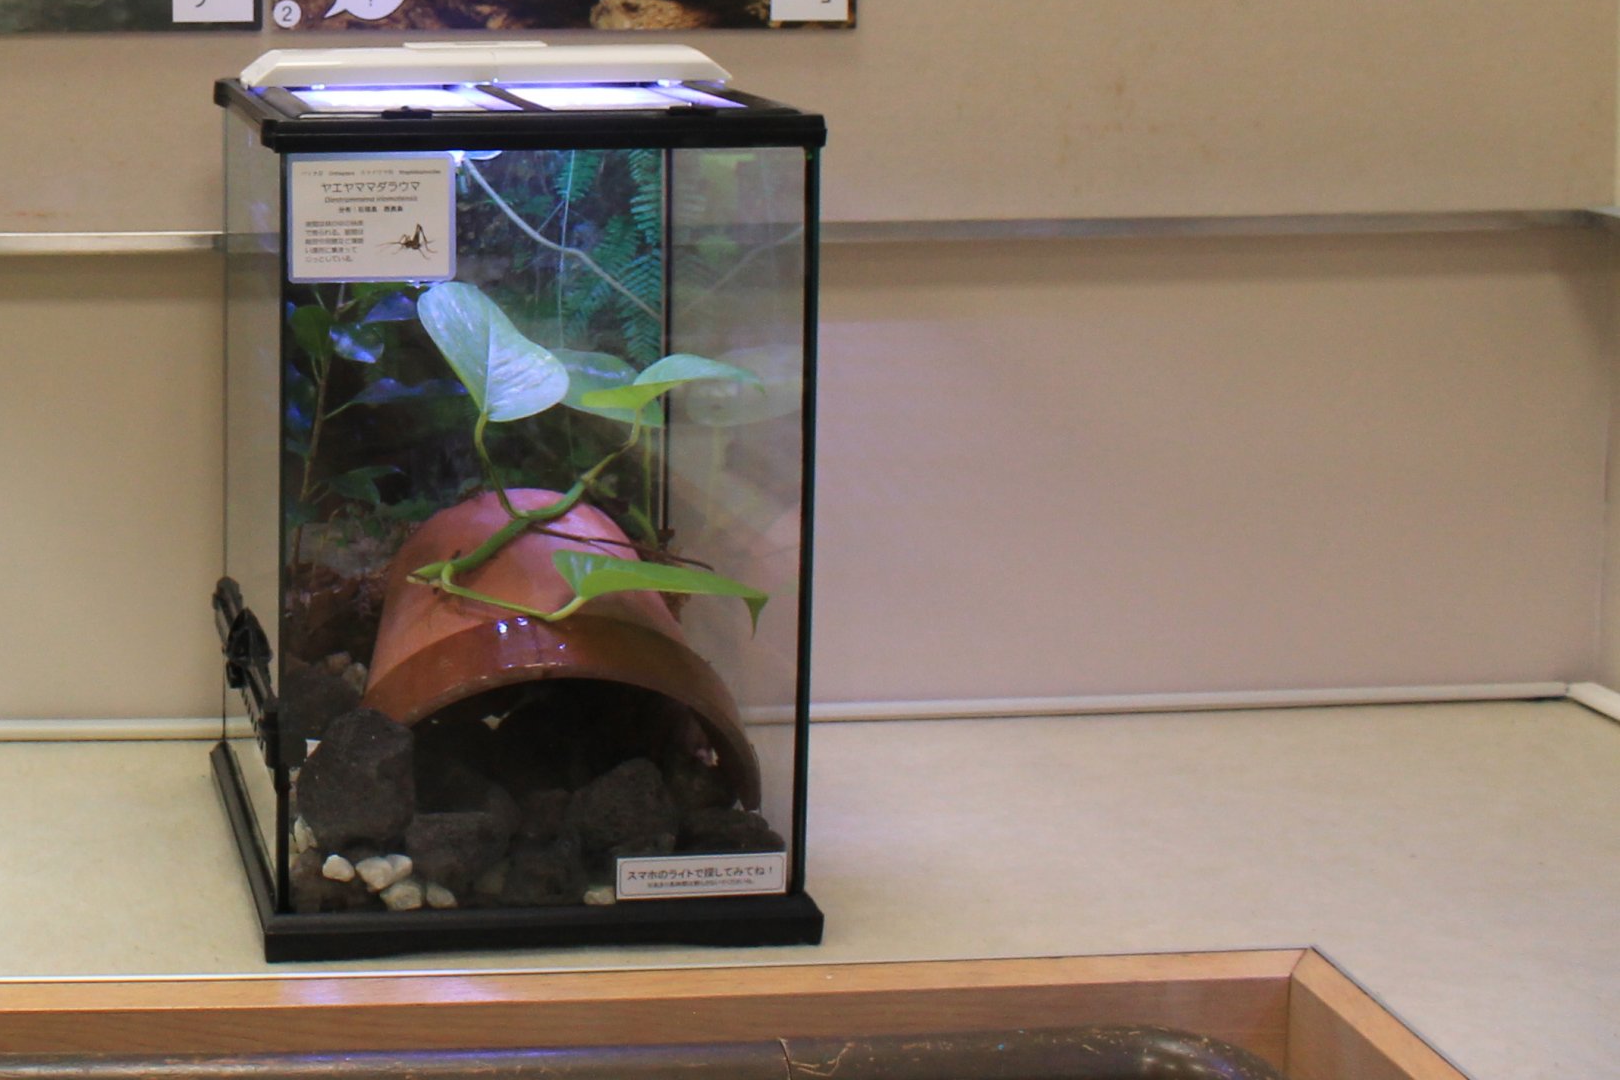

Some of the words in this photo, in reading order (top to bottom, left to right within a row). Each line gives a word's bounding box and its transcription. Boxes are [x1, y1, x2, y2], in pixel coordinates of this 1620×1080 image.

[281, 4, 292, 23] 2
[320, 180, 421, 194] ヤエヤママダラウマ
